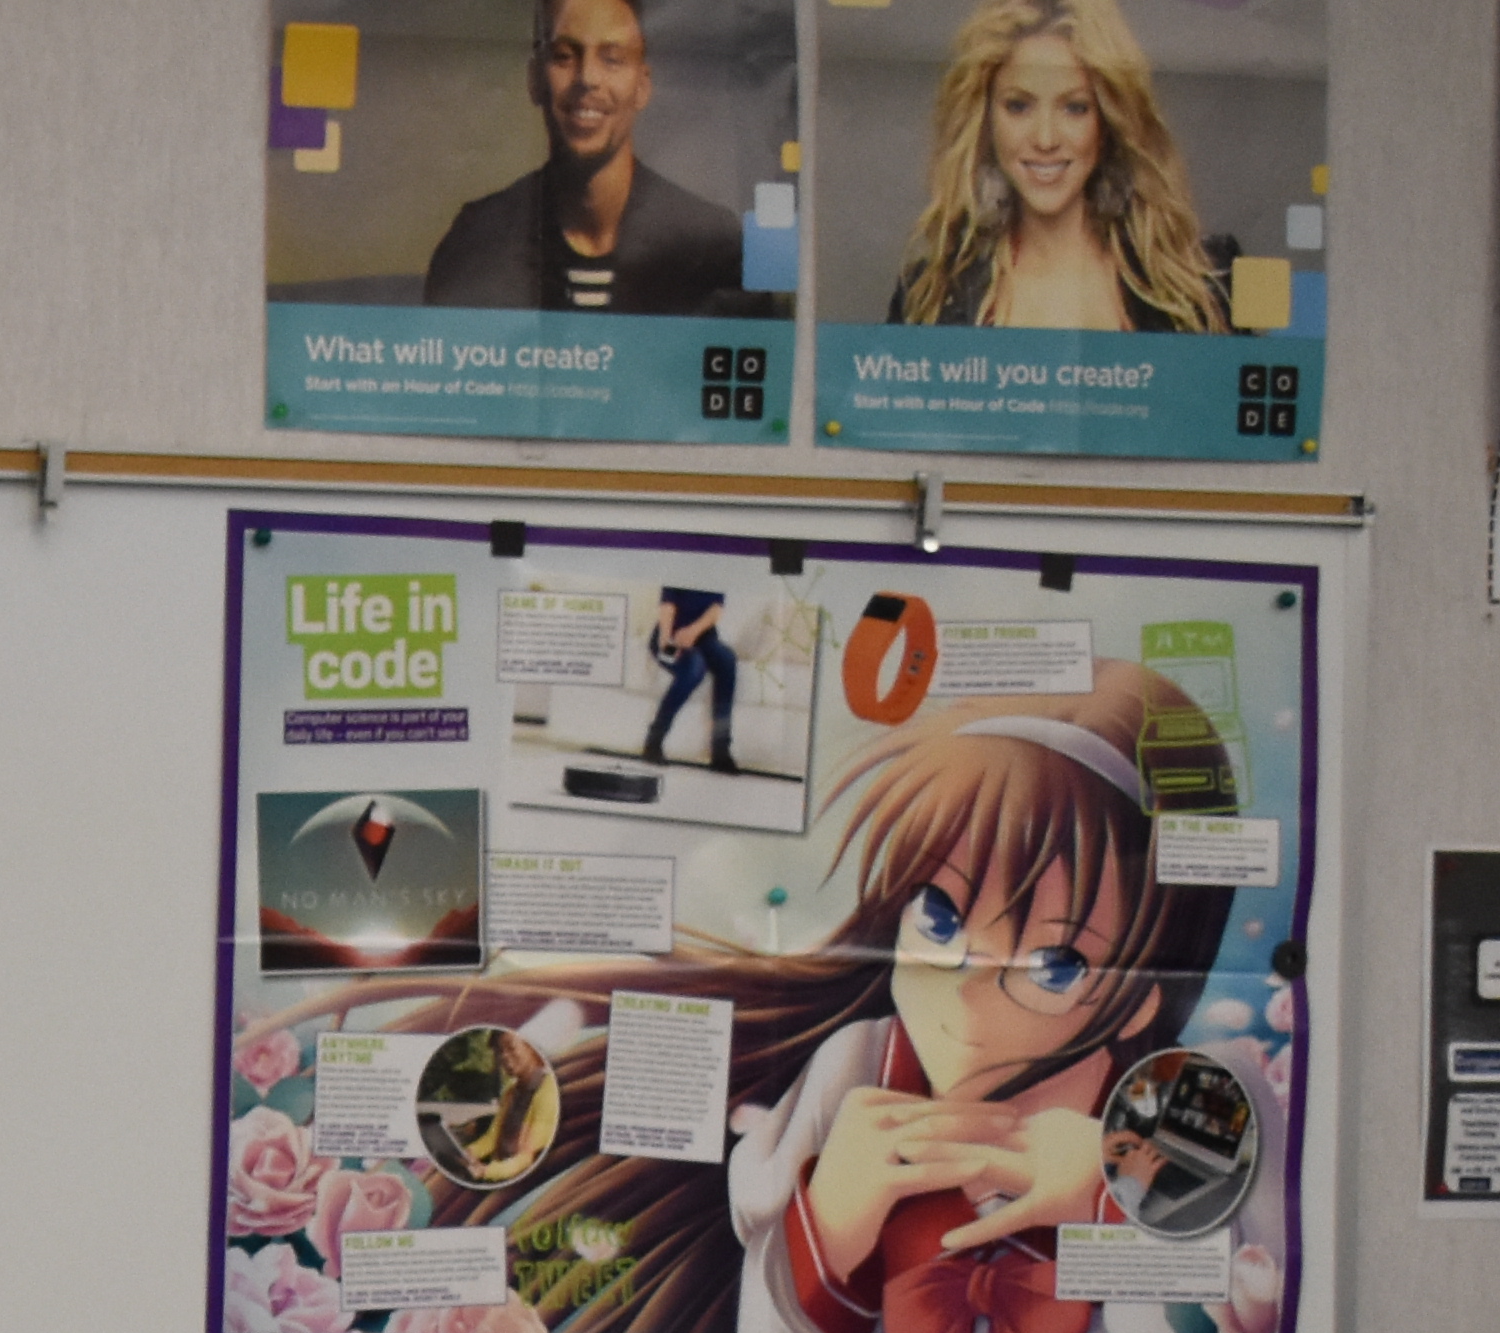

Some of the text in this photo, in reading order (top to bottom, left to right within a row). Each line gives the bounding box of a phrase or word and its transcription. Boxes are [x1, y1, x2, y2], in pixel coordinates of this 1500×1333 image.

[304, 335, 615, 371] What will you create?
[305, 376, 342, 391] Start
[345, 378, 379, 393] with
[404, 379, 441, 395] Hour
[444, 380, 463, 395] of
[465, 380, 504, 396] Code
[854, 354, 1155, 389] What will you create?
[854, 394, 889, 410] Start
[949, 397, 983, 412] Hour
[988, 397, 1004, 412] of
[1008, 399, 1045, 414] Code
[290, 581, 456, 635] Life in
[308, 640, 439, 690] code
[287, 711, 342, 726] Computer
[346, 711, 388, 724] science
[281, 890, 318, 910] NO
[423, 886, 468, 907] SKY
